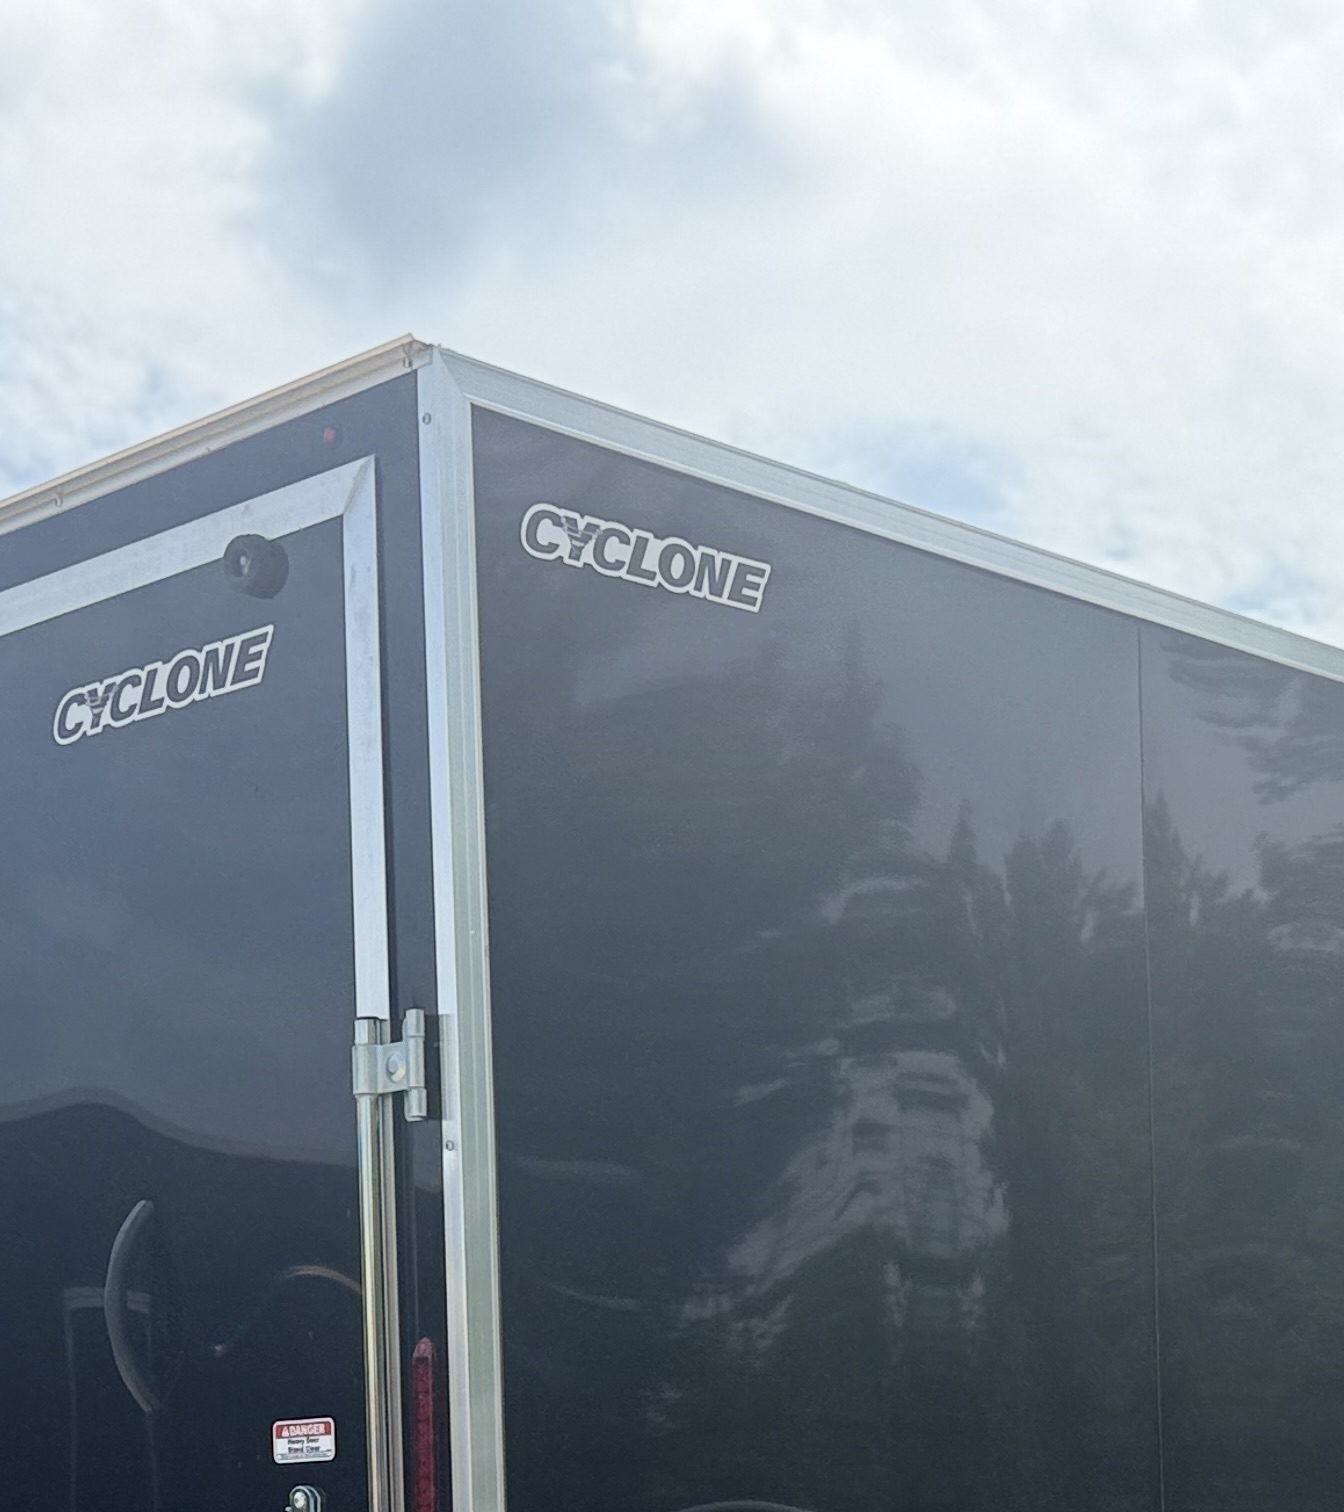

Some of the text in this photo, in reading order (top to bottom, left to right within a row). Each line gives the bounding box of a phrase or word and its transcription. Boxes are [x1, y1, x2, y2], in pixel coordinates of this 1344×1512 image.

[519, 502, 772, 613] CYCLONE
[52, 625, 275, 746] CYCLONE
[289, 1424, 325, 1436] DANGER
